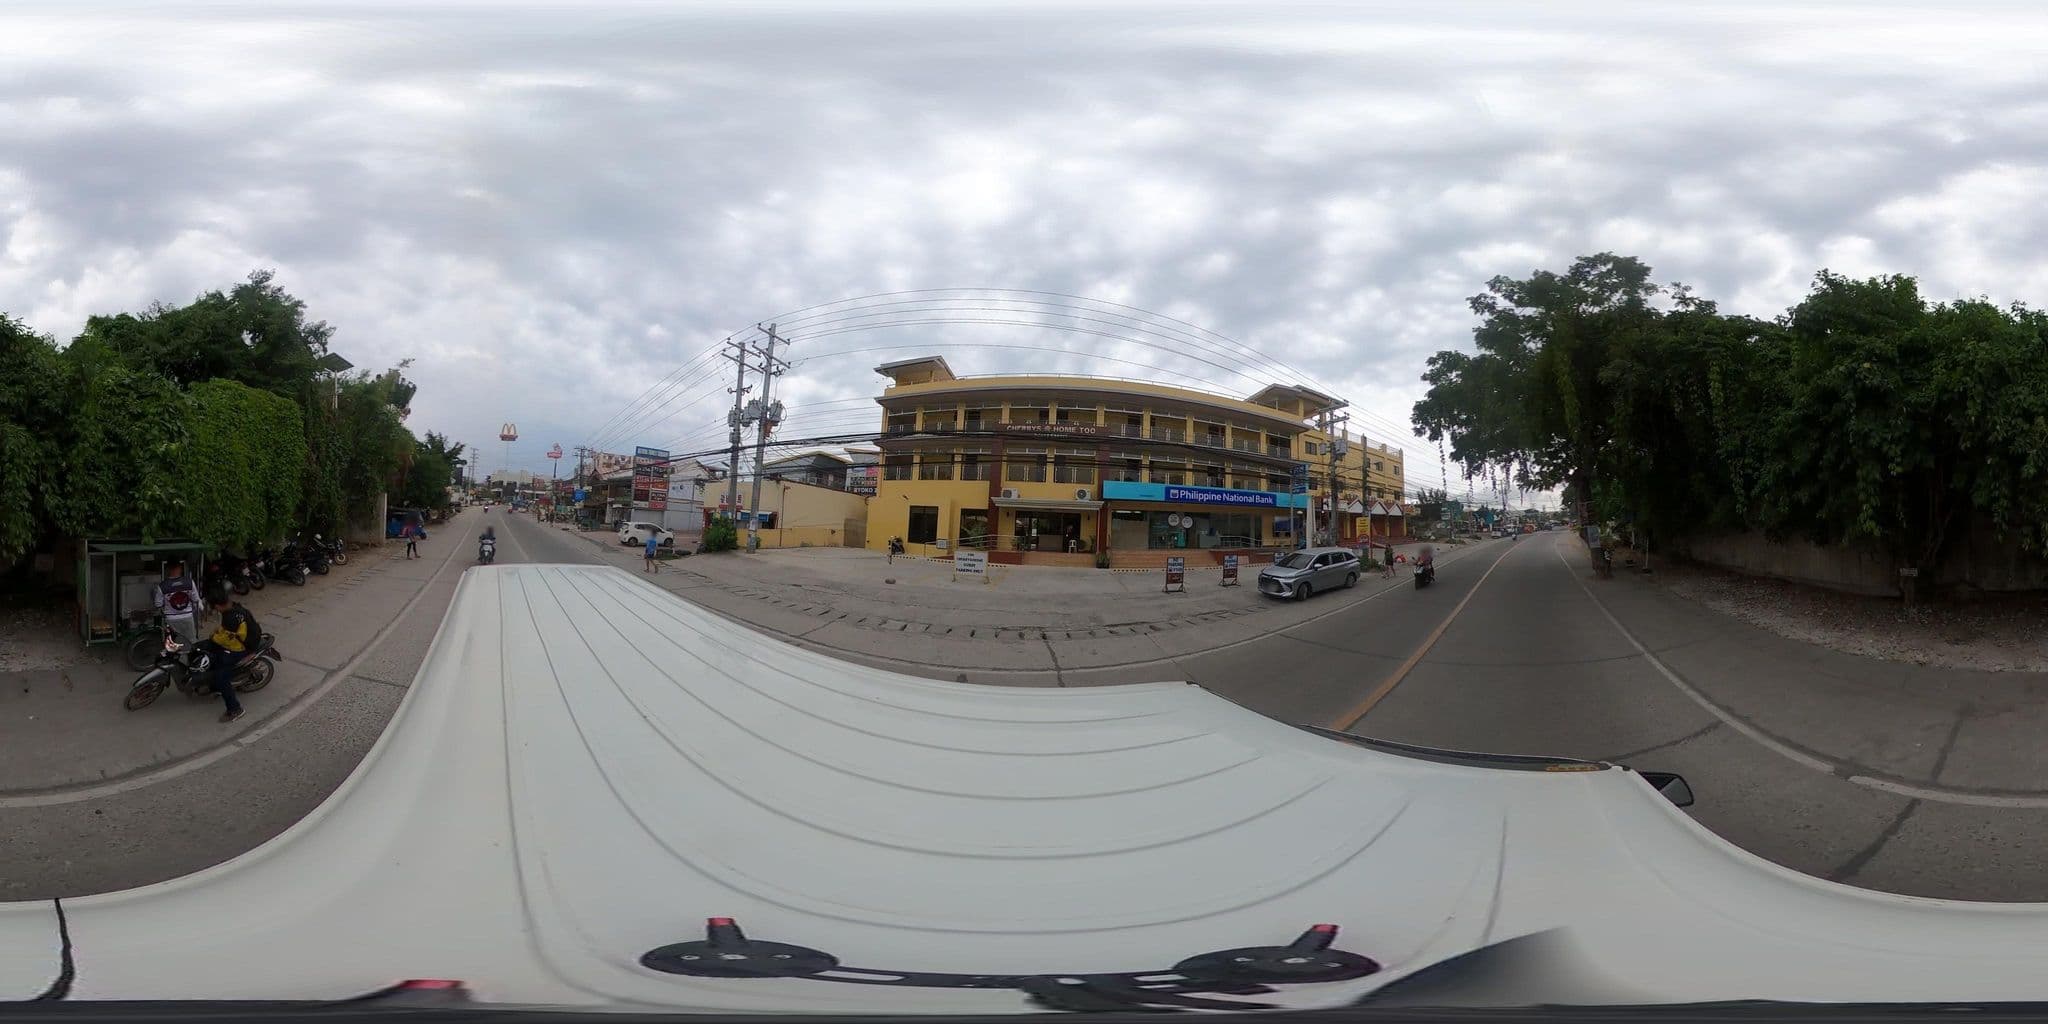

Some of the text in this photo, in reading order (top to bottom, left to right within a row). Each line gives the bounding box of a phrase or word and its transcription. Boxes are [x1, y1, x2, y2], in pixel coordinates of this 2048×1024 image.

[1180, 489, 1274, 504] Philippine National Bank
